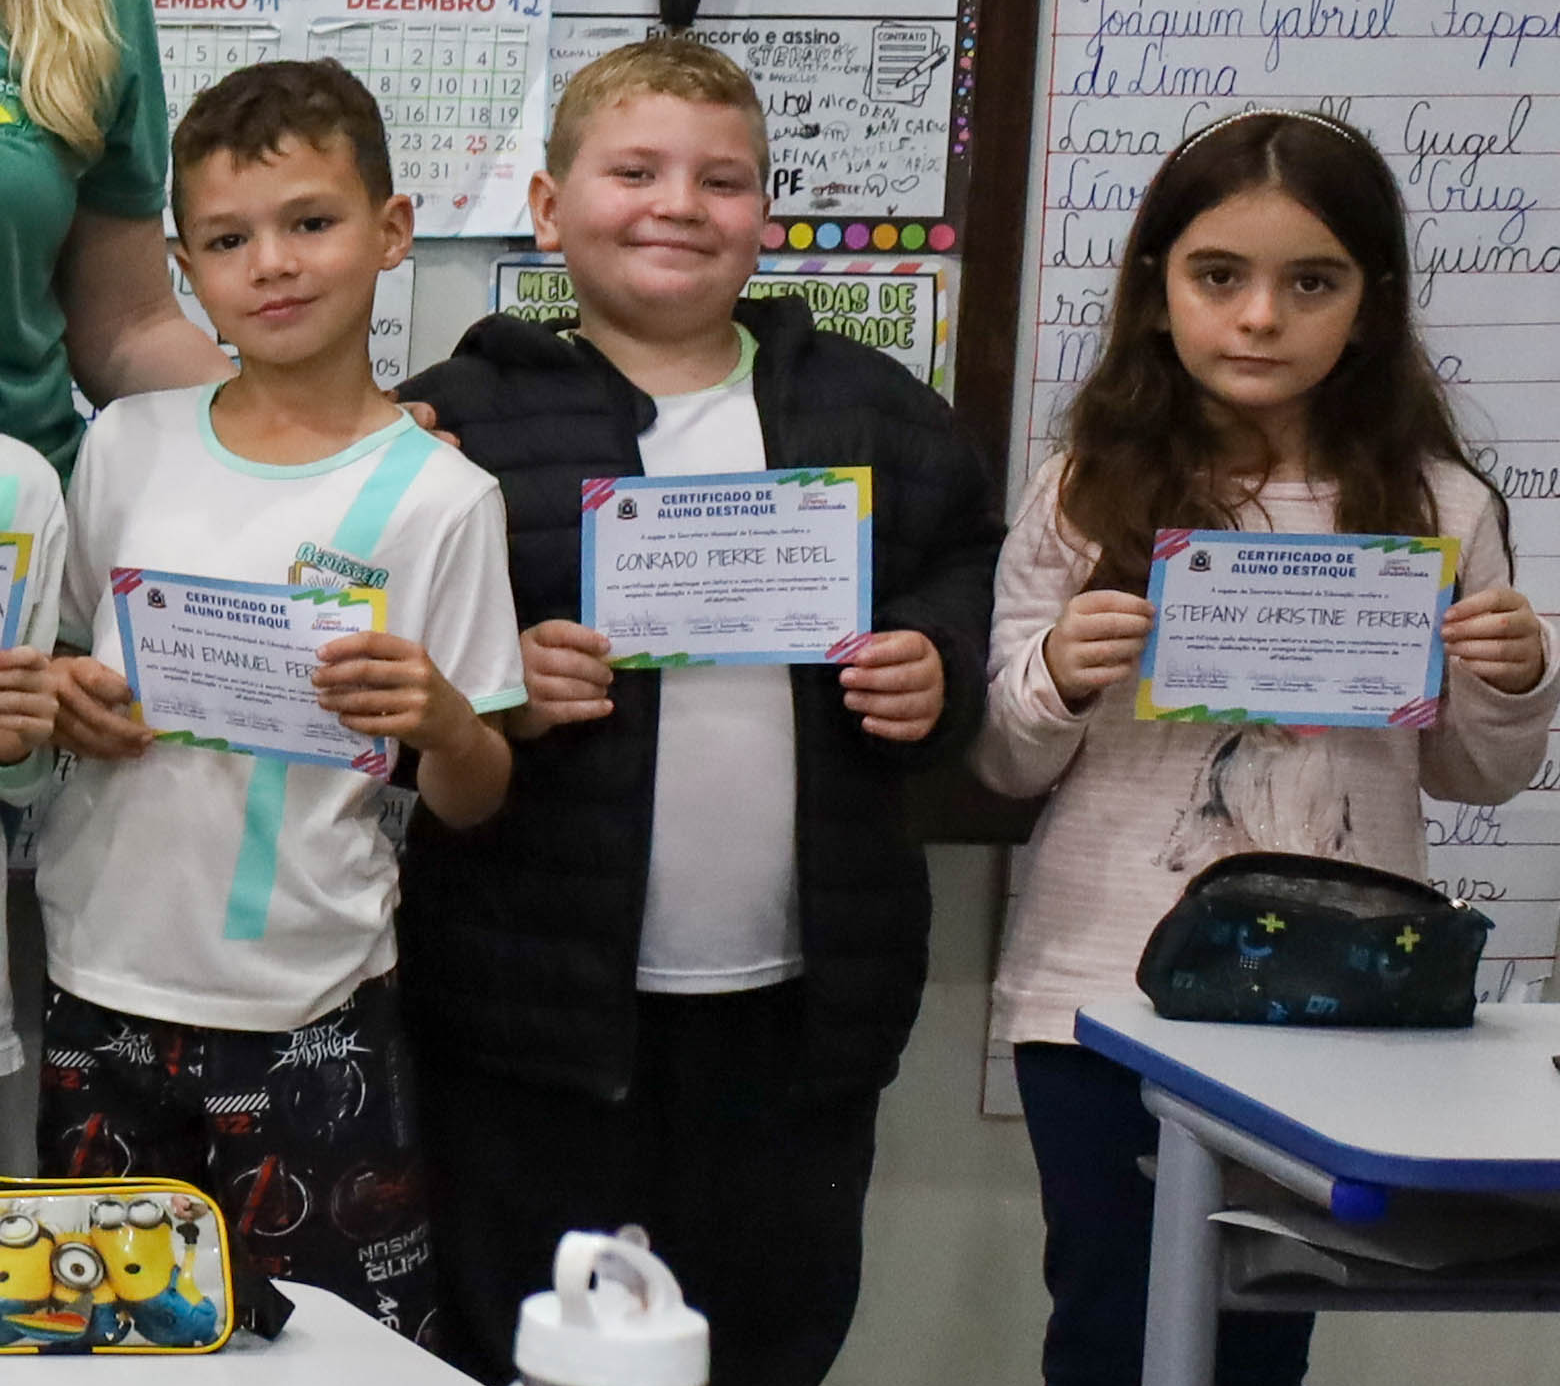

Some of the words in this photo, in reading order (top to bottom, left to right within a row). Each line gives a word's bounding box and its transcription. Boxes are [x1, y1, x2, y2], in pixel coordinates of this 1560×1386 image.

[783, 28, 840, 45] assino
[1126, 43, 1238, 98] Lima
[616, 550, 698, 572] CONRADO
[707, 547, 766, 567] PIERRE
[776, 545, 837, 564] NEDEL
[1282, 564, 1357, 578] DESTAQUE
[1165, 604, 1249, 622] STEFANY
[1257, 607, 1346, 627] CHRISTINE
[1357, 610, 1431, 629] PEREIRA
[140, 636, 194, 660] ALLAN
[202, 645, 278, 674] EMANUEL
